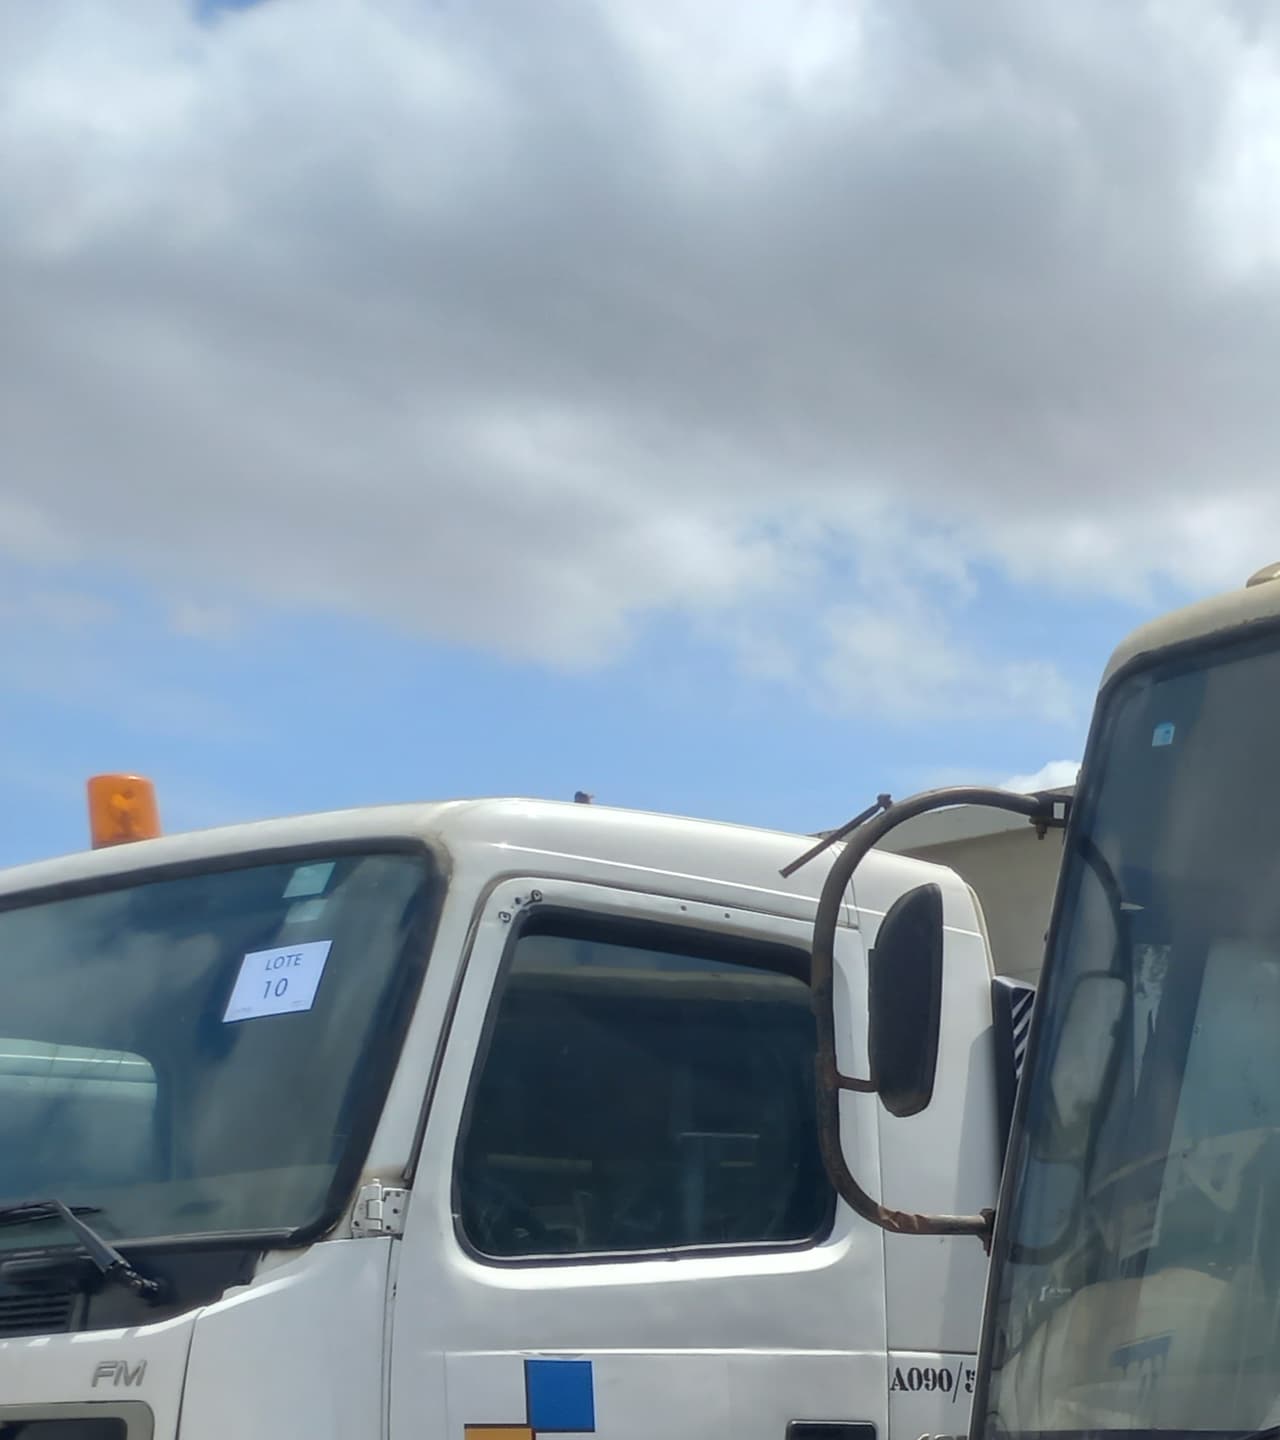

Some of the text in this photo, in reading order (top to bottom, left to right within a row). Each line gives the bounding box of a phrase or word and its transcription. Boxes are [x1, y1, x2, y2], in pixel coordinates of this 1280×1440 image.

[265, 953, 304, 971] LOTE
[263, 977, 289, 999] 10
[91, 1359, 147, 1388] FM
